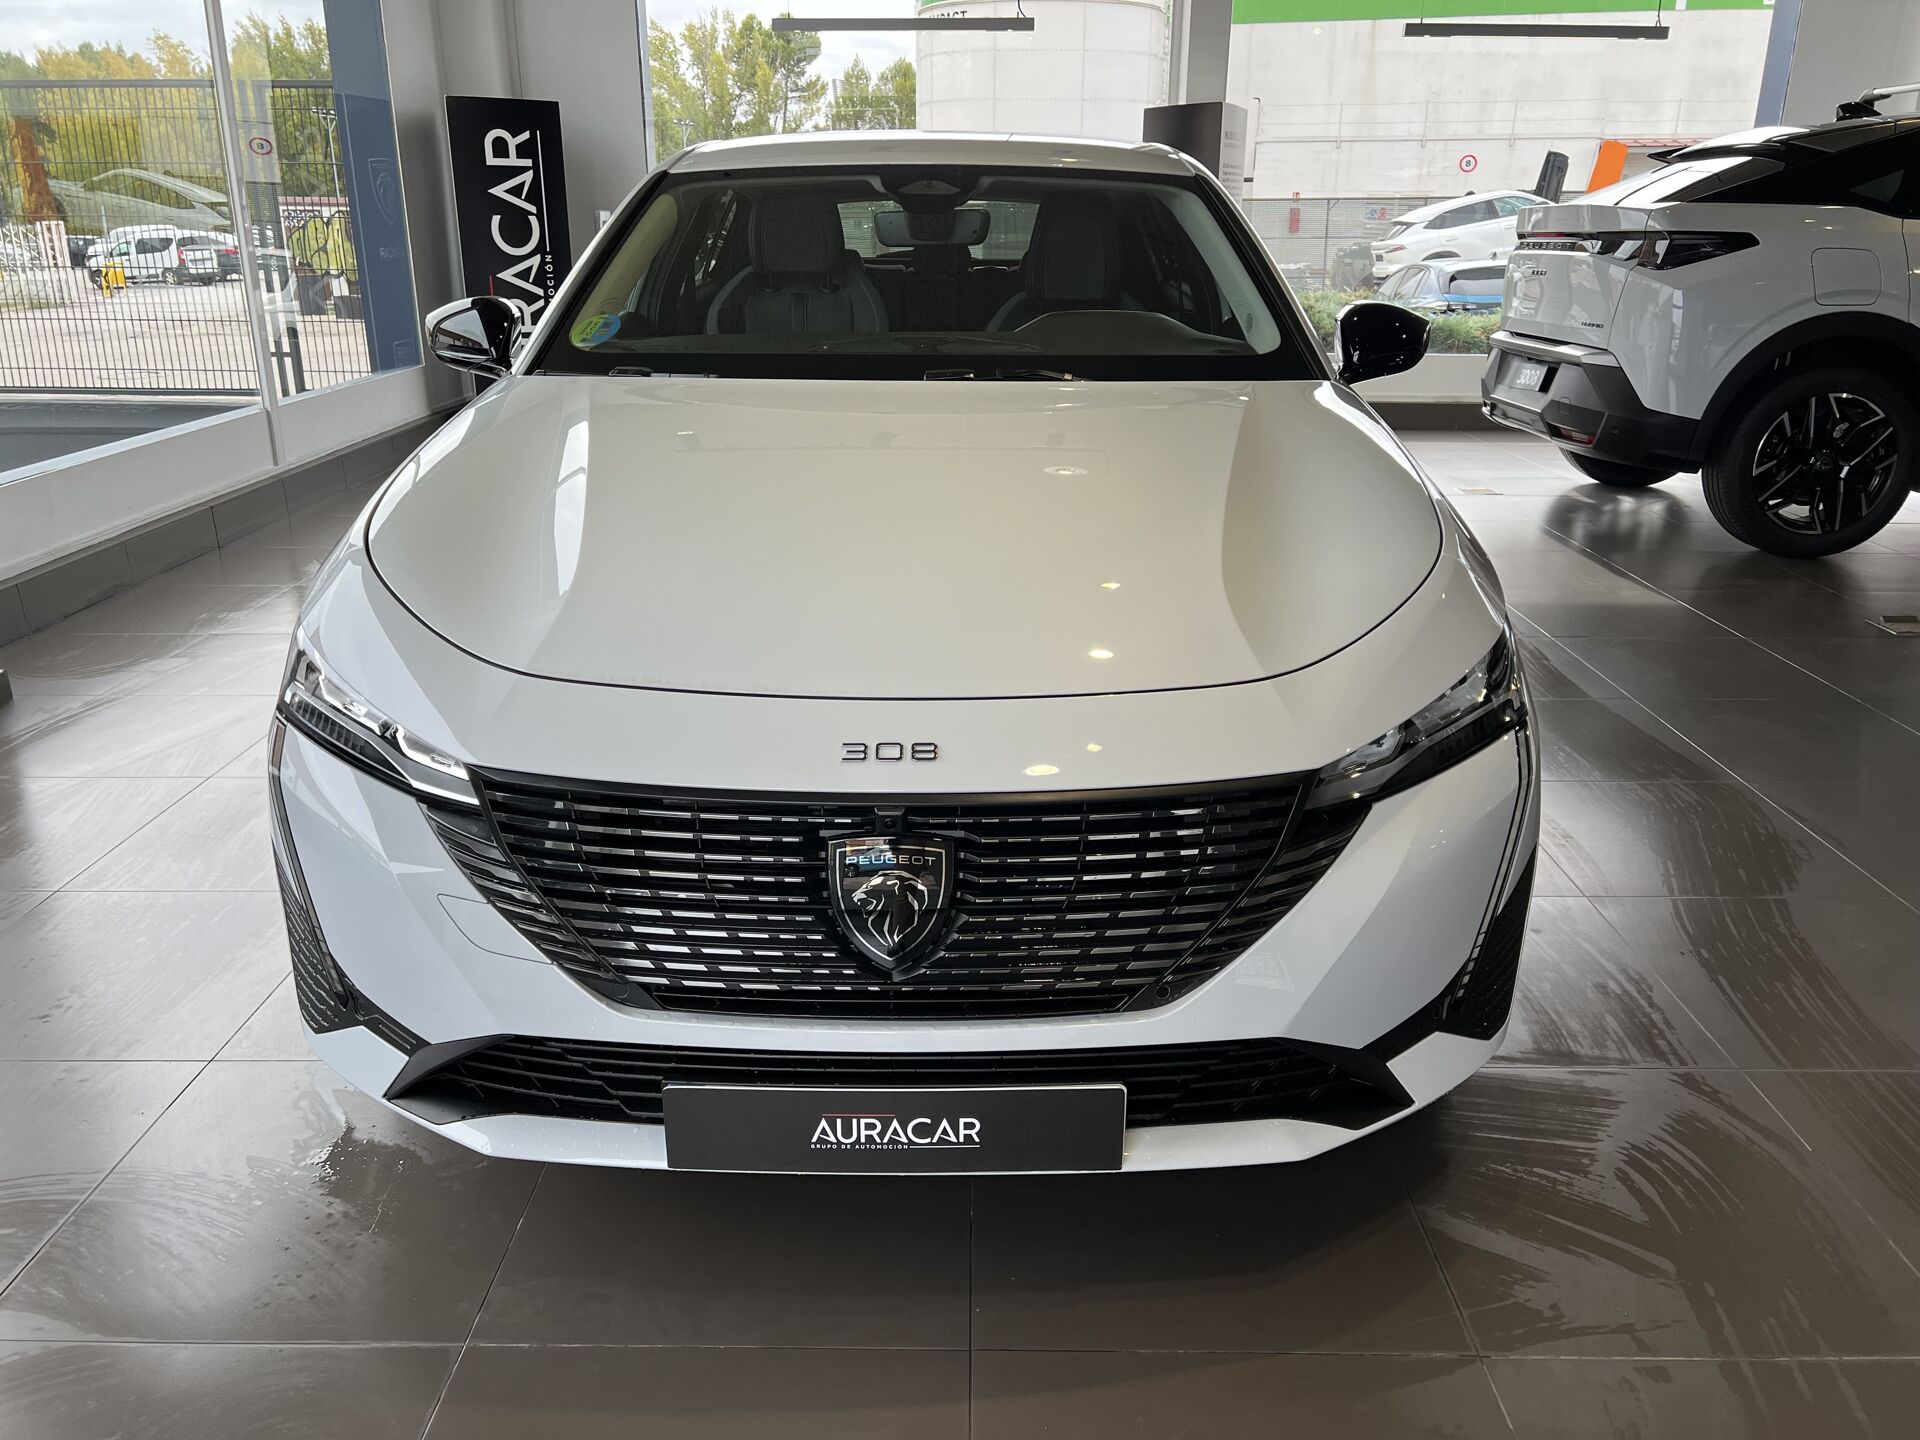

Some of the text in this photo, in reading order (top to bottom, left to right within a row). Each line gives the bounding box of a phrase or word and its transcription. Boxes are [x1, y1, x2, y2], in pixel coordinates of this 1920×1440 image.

[1465, 159, 1471, 167] 8
[1516, 368, 1540, 386] 3008
[841, 742, 938, 761] 308
[845, 854, 936, 866] PEUGEOT
[810, 1117, 981, 1144] AURACAR
